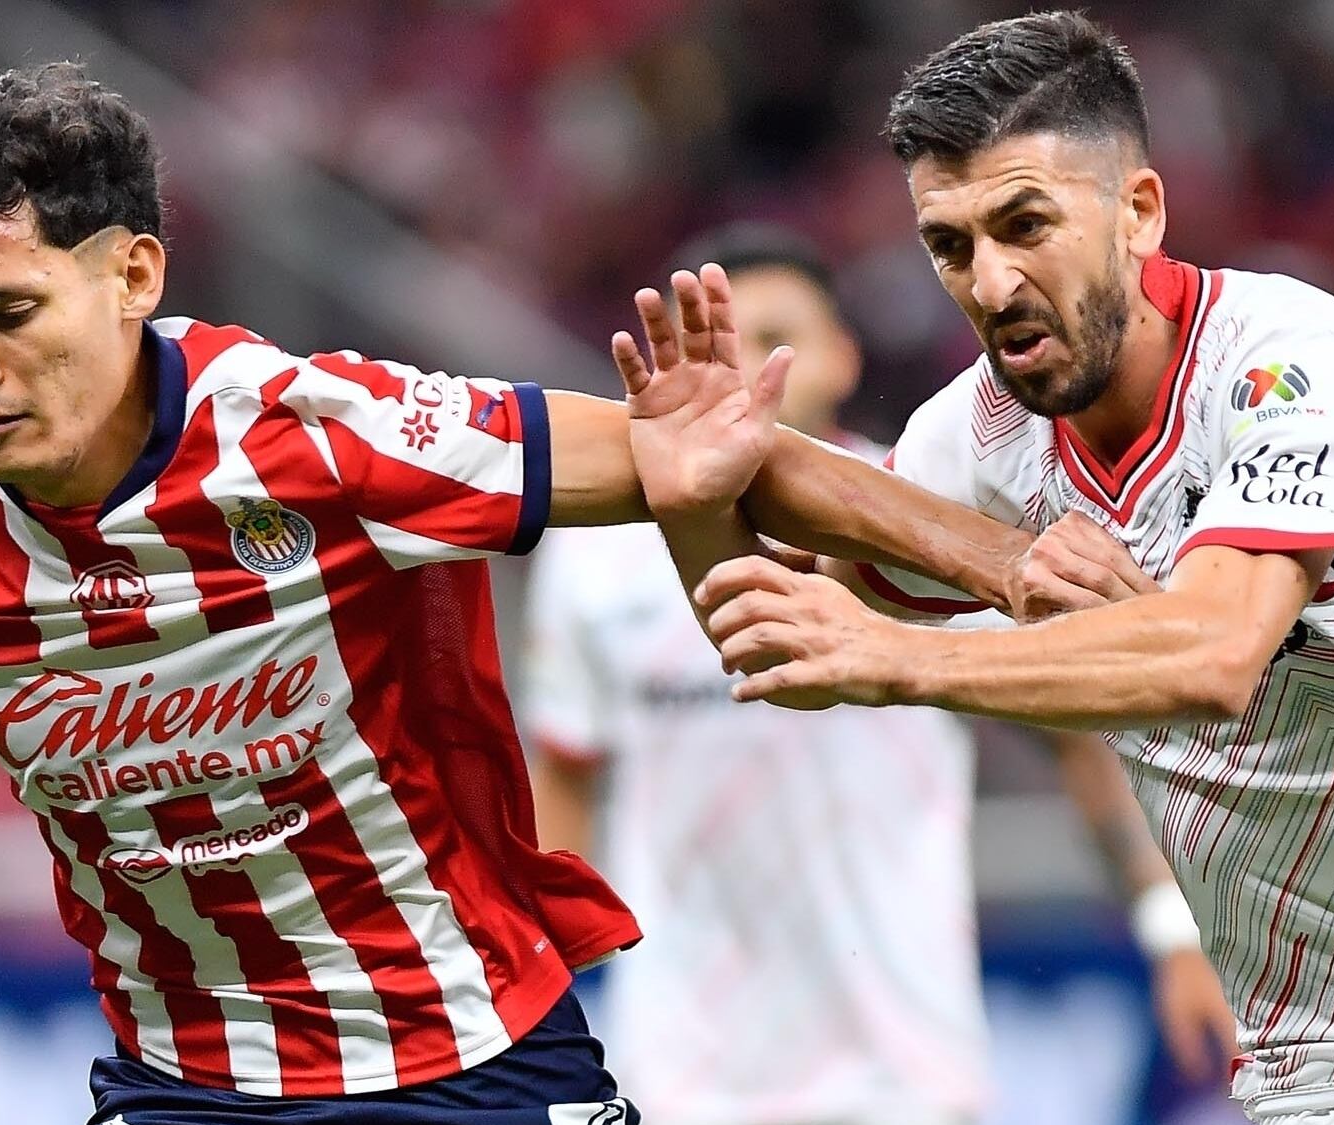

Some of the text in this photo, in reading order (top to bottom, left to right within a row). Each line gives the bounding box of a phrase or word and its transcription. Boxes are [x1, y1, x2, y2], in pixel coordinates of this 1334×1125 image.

[1256, 407, 1301, 422] BBVA
[1241, 475, 1329, 508] Cola
[35, 720, 326, 802] caliente.mx
[180, 808, 302, 864] mercado
